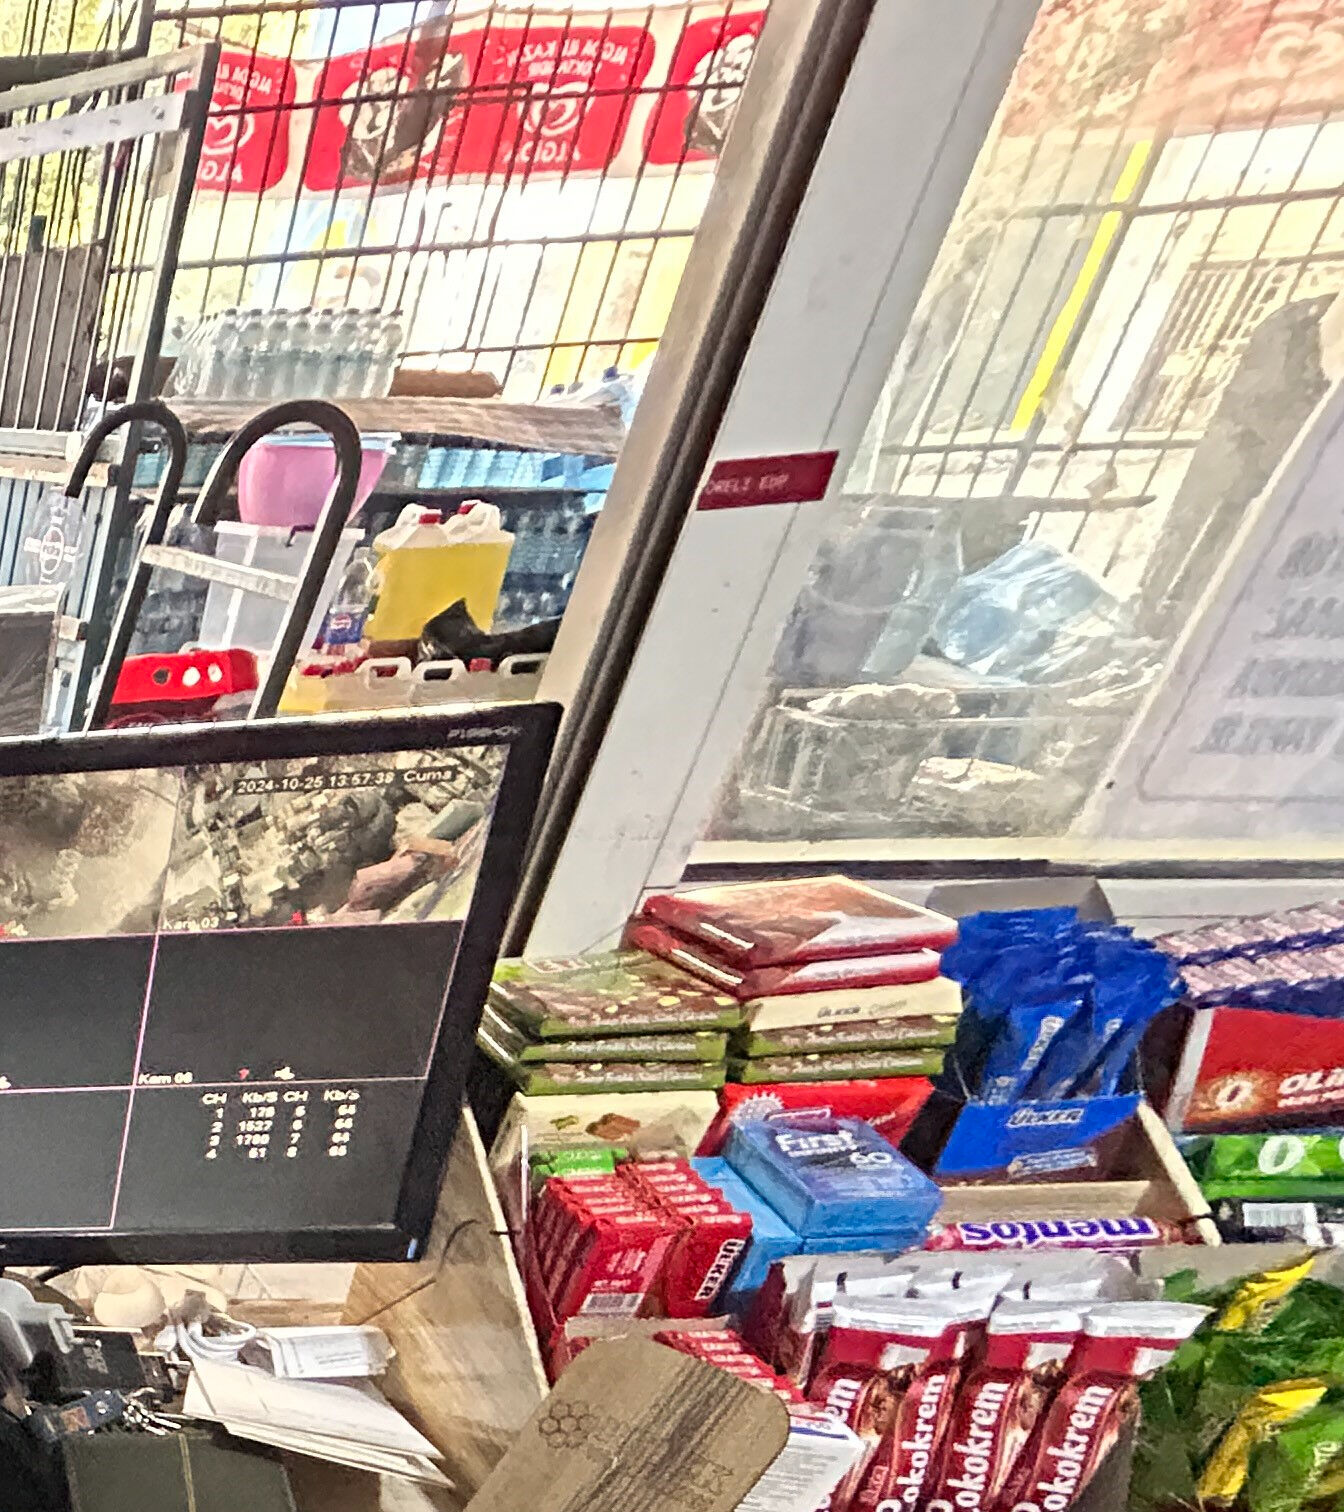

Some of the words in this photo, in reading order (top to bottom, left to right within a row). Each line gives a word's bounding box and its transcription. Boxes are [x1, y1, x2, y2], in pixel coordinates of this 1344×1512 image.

[237, 774, 324, 795] 2024-10-25
[328, 770, 396, 788] 13:57:38
[402, 767, 454, 784] Cuma
[200, 916, 220, 929] 03
[137, 1073, 172, 1085] Kam
[202, 1092, 227, 1104] CH
[283, 1090, 309, 1103] CH
[216, 1107, 224, 1118] 1
[1006, 1107, 1085, 1128] ÜLKER
[211, 1121, 223, 1133] 2
[290, 1132, 301, 1144] 7
[775, 1130, 860, 1153] First
[205, 1148, 217, 1159] 4
[959, 1217, 1160, 1246] mentos
[693, 1238, 746, 1301] ÜLKER
